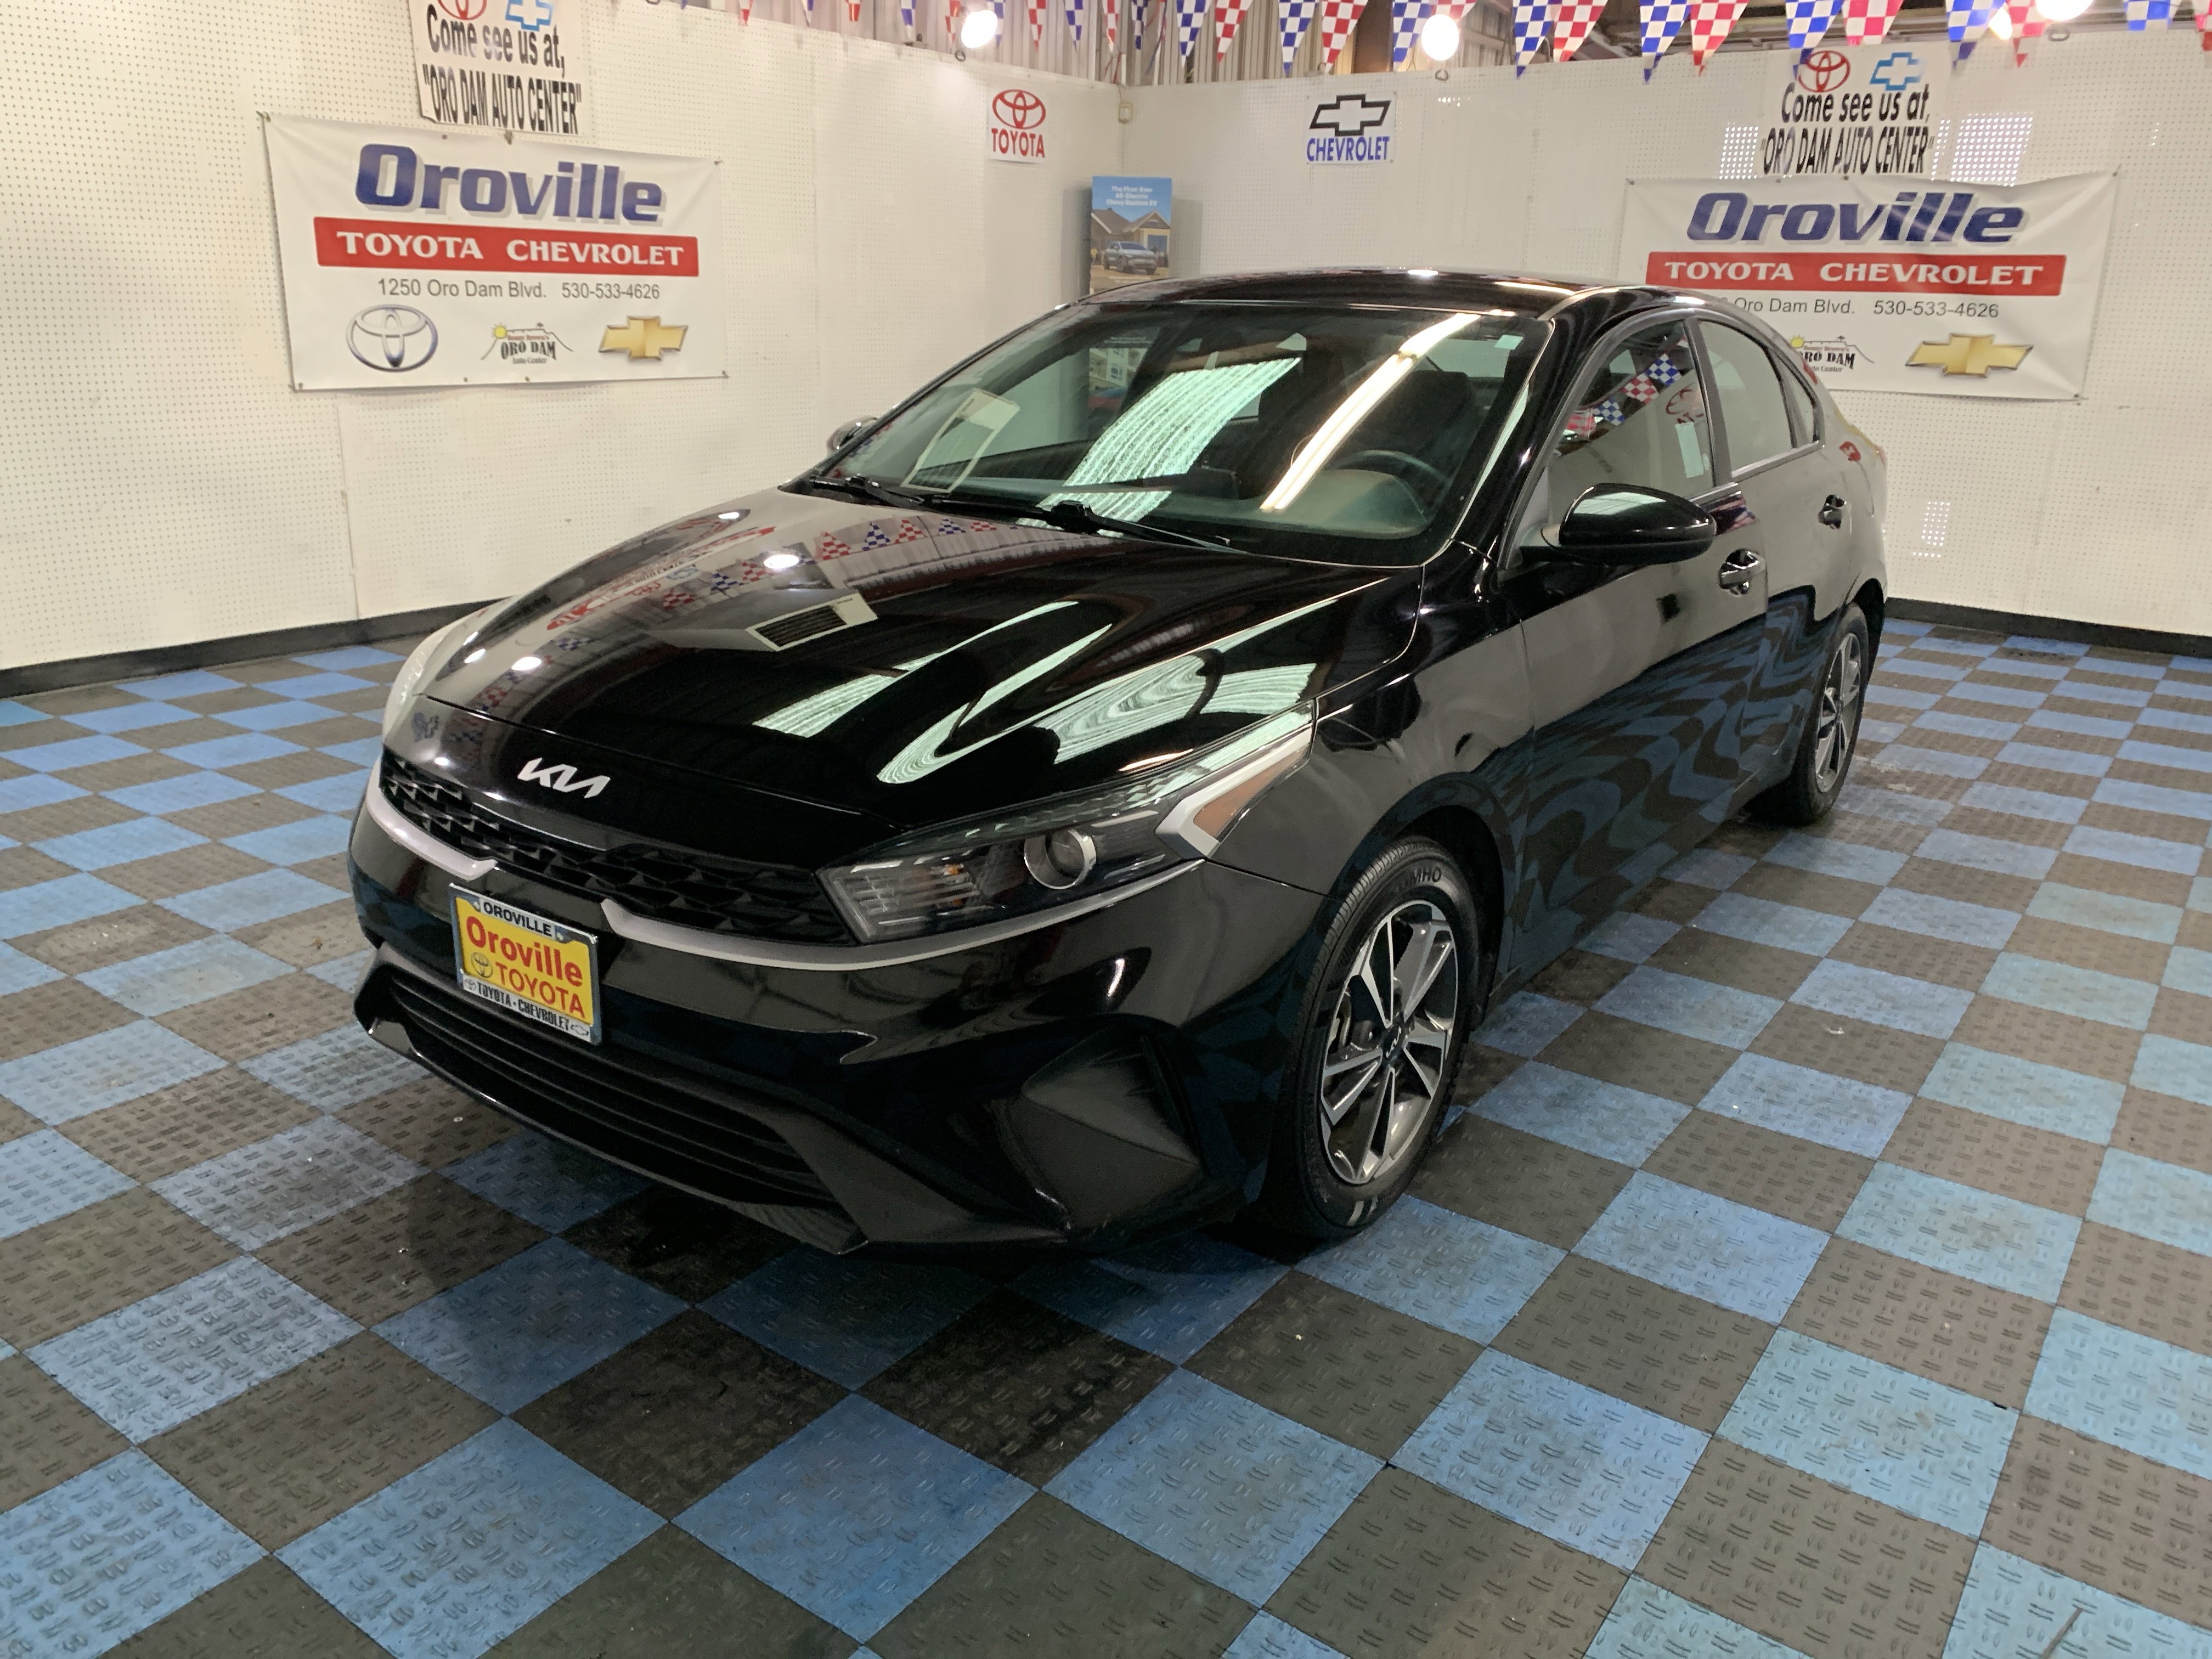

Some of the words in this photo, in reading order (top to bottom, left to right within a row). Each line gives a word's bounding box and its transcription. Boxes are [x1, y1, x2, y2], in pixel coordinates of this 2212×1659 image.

[427, 4, 477, 58] Come
[483, 25, 513, 63] see
[518, 30, 538, 65] us
[544, 25, 565, 78] at,
[459, 69, 489, 126] DAM
[492, 72, 524, 130] AUTO
[1781, 82, 1835, 123] Come
[1838, 92, 1872, 123] see
[1878, 92, 1902, 121] us
[1907, 83, 1931, 123] at,
[991, 128, 1045, 158] TOYOTA
[1306, 136, 1390, 161] CHEVROLET
[1796, 127, 1833, 174] DAM
[1832, 126, 1874, 175] AUTO
[355, 143, 663, 222] Oroville
[1686, 192, 2024, 244] Oroville
[336, 231, 484, 259] TOYOTA
[506, 239, 684, 266] CHEVROLET
[378, 278, 421, 297] 1250
[428, 279, 459, 297] Oro
[465, 280, 503, 297] Dam
[509, 280, 547, 298] Blvd.
[562, 282, 660, 300] 530-533-4626
[1664, 261, 1795, 281] TOYOTA
[1819, 262, 2044, 286] CHEVROLET
[1769, 298, 1807, 313] Dam
[1814, 298, 1855, 314] Blvd.
[1873, 299, 1999, 319] 530-533-4626
[501, 341, 527, 360] ORO
[531, 341, 556, 361] DAM
[1800, 351, 1822, 362] RO
[1827, 352, 1855, 370] DAM
[517, 757, 610, 799] KIA
[483, 901, 552, 937] OROVILLE
[466, 916, 583, 987] Oroville
[477, 981, 511, 1007] TOYOTA
[518, 999, 569, 1031] CHEVROLET
[495, 962, 585, 1018] TOYOTA
